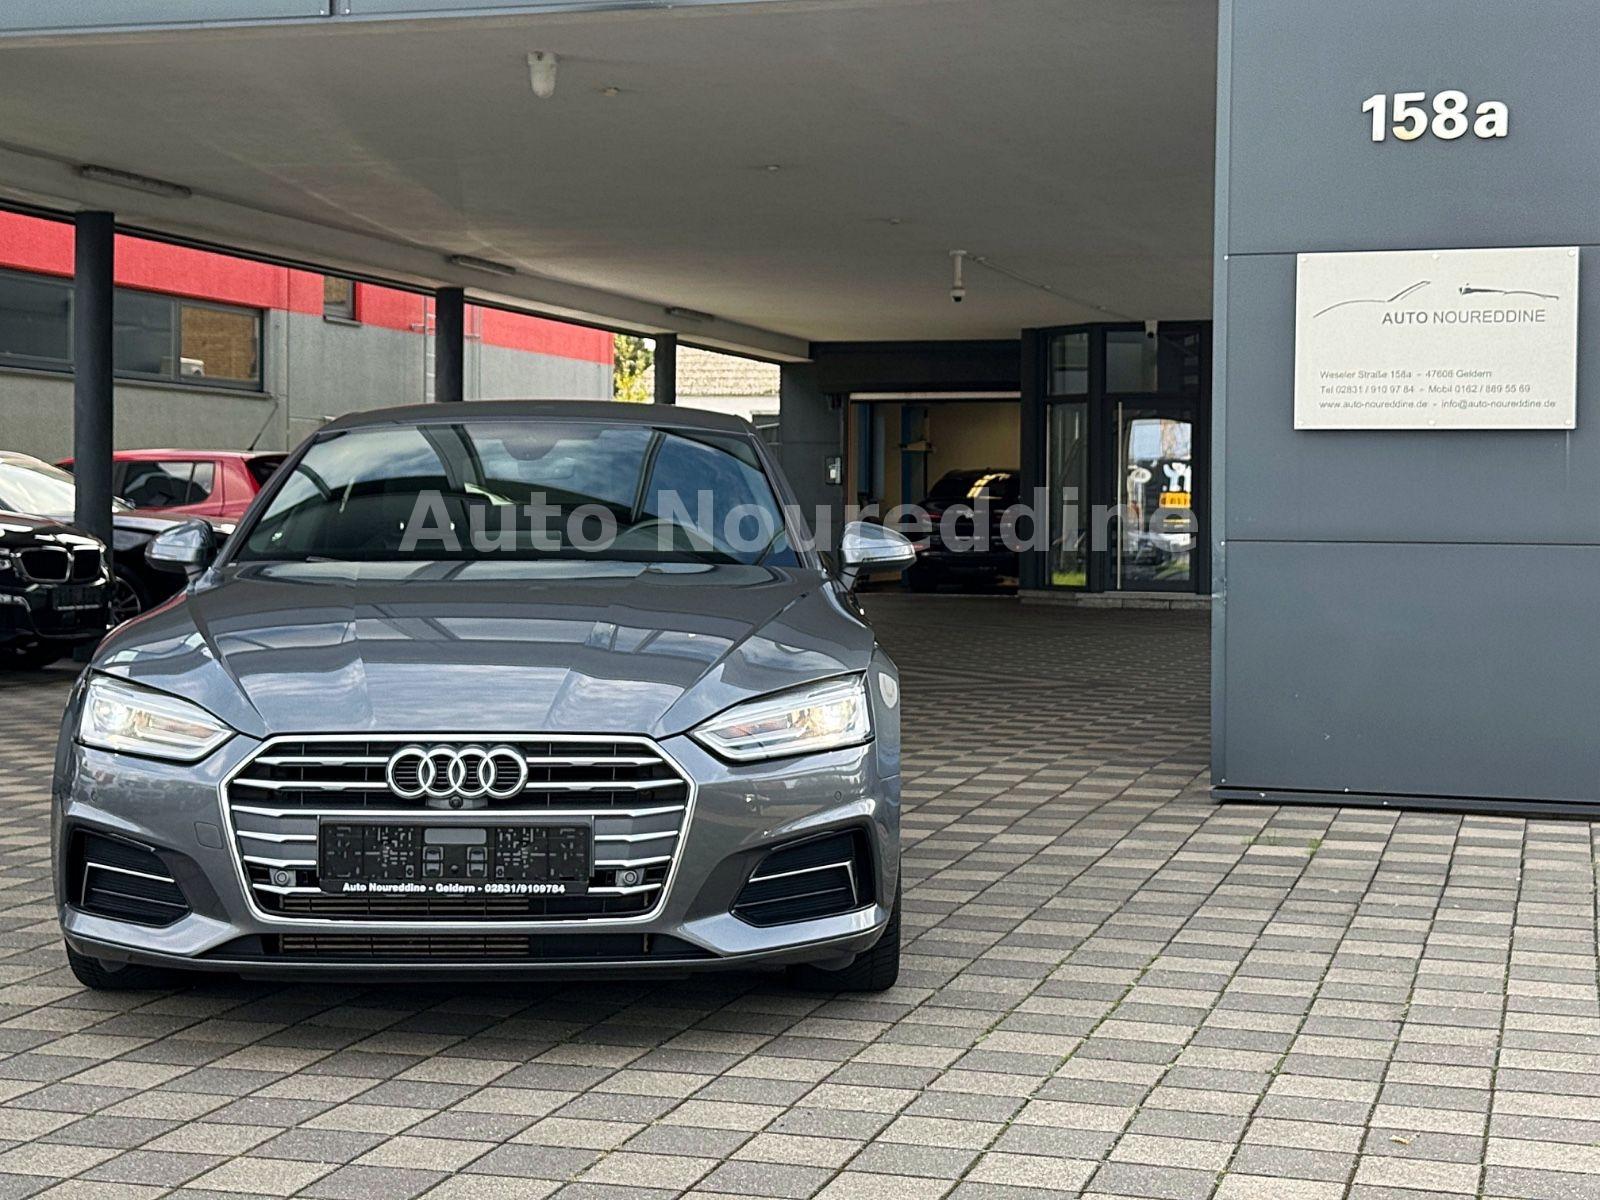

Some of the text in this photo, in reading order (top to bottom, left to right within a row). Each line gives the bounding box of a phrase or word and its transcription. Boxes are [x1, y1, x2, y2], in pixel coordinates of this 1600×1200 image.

[1362, 89, 1509, 142] 158a
[1382, 309, 1546, 325] AUTO NOUREDDINE
[1320, 370, 1356, 379] Weseler
[1456, 369, 1492, 378] Geldern
[1335, 385, 1362, 394] 02831
[1428, 384, 1453, 393] Mobil
[1319, 400, 1428, 409] www.auto-noureddine.de
[342, 882, 367, 892] Auto
[368, 882, 427, 893] Noureddine
[435, 883, 476, 893] Geldern
[484, 883, 566, 894] 02831/9109784
